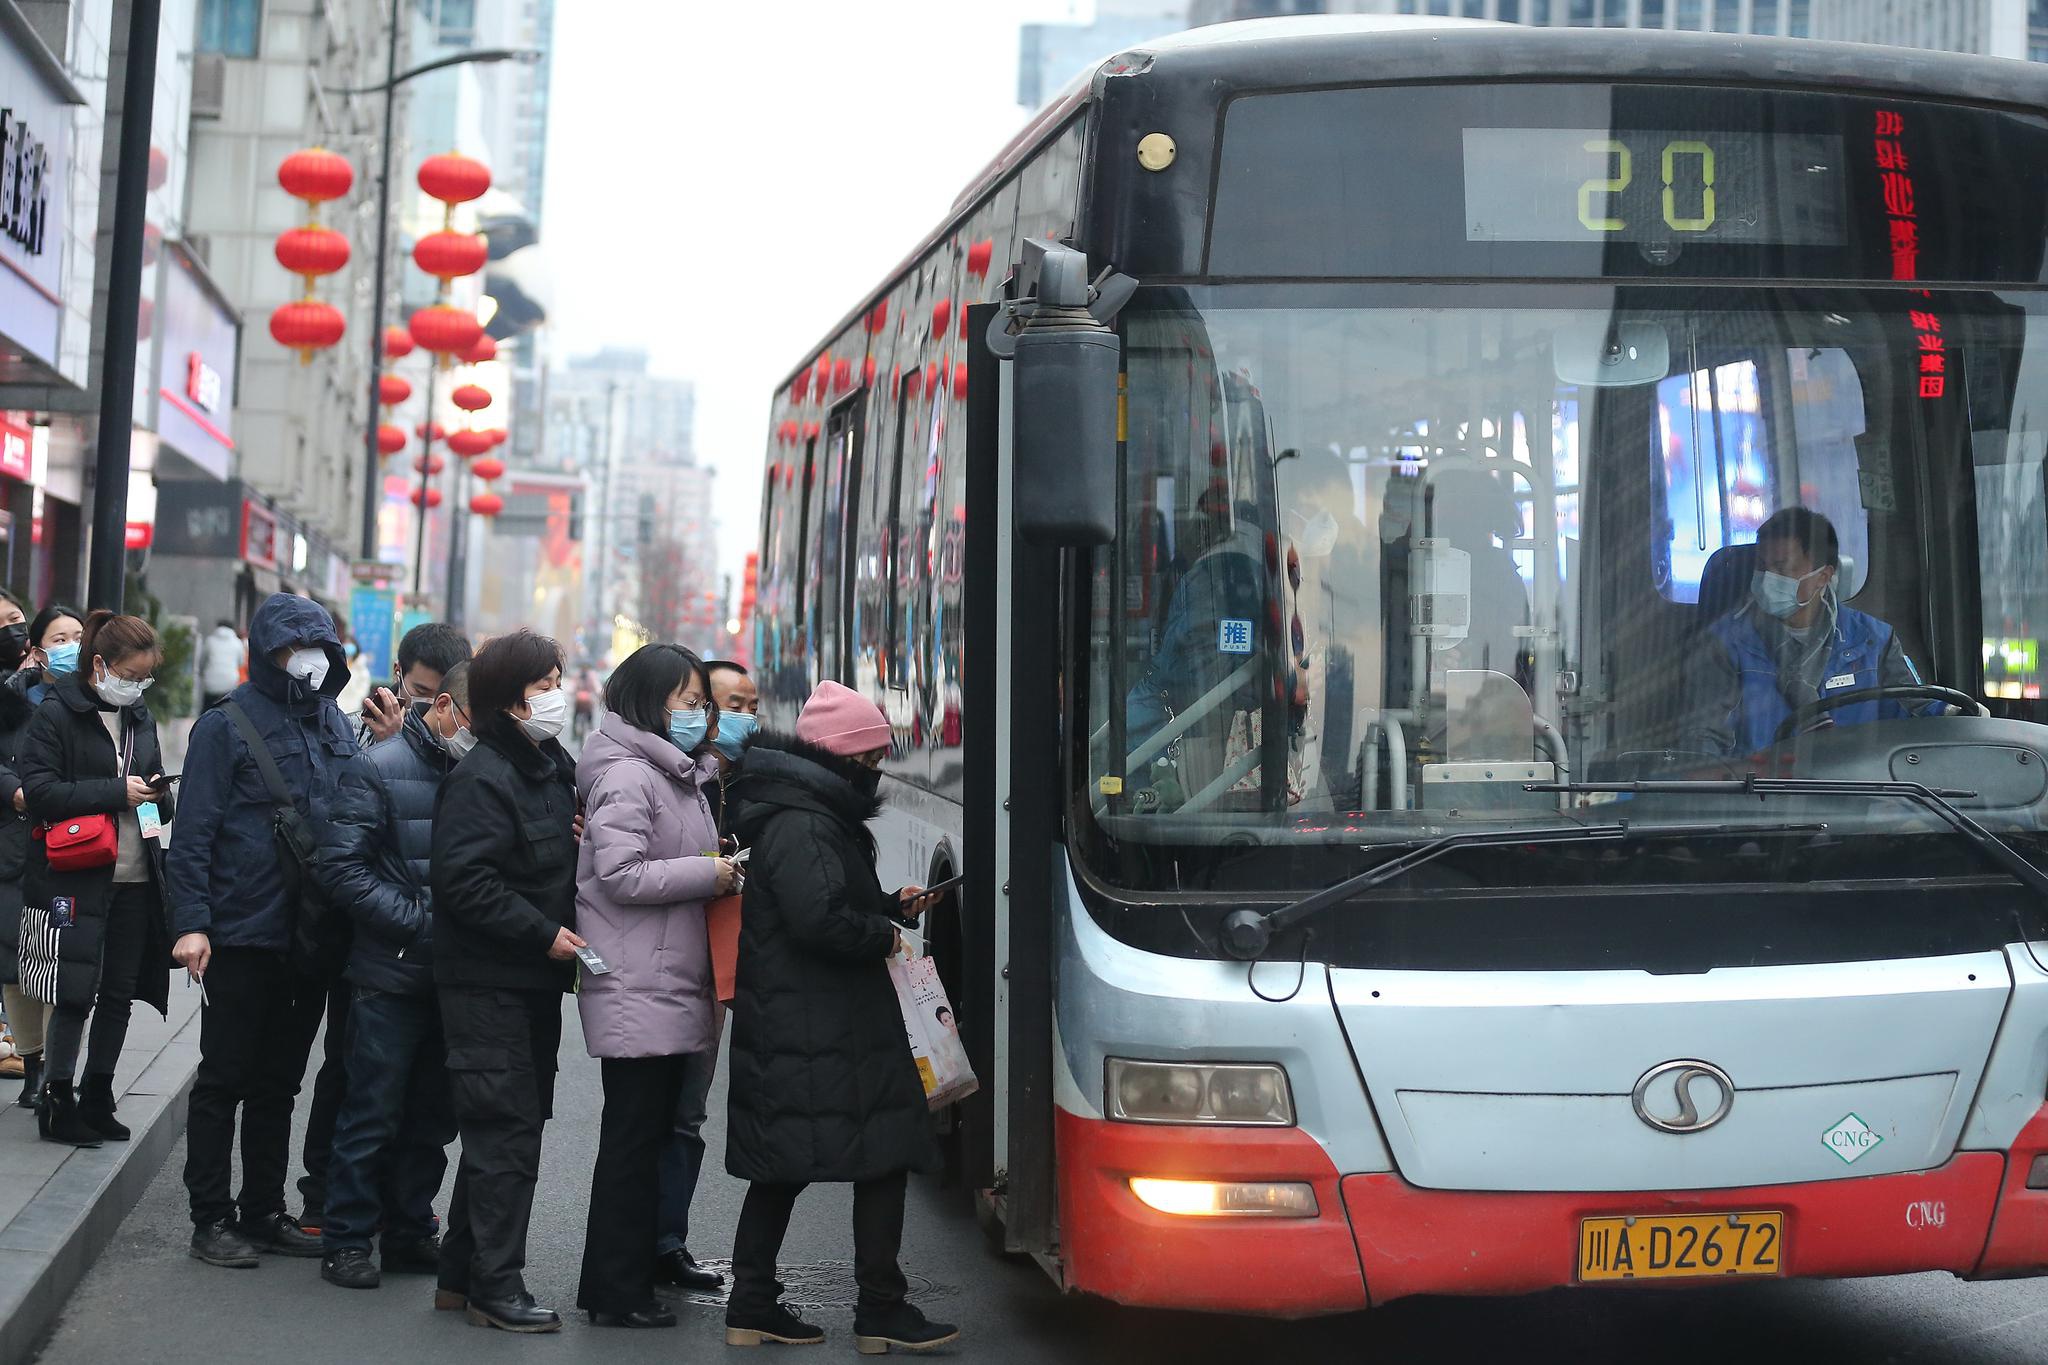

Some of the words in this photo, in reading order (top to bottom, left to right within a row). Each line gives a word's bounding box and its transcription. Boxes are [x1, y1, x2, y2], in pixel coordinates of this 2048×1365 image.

[1578, 140, 1715, 231] 20
[1224, 622, 1248, 644] 推
[1831, 1130, 1871, 1148] CNG
[1906, 1202, 1946, 1227] CNG
